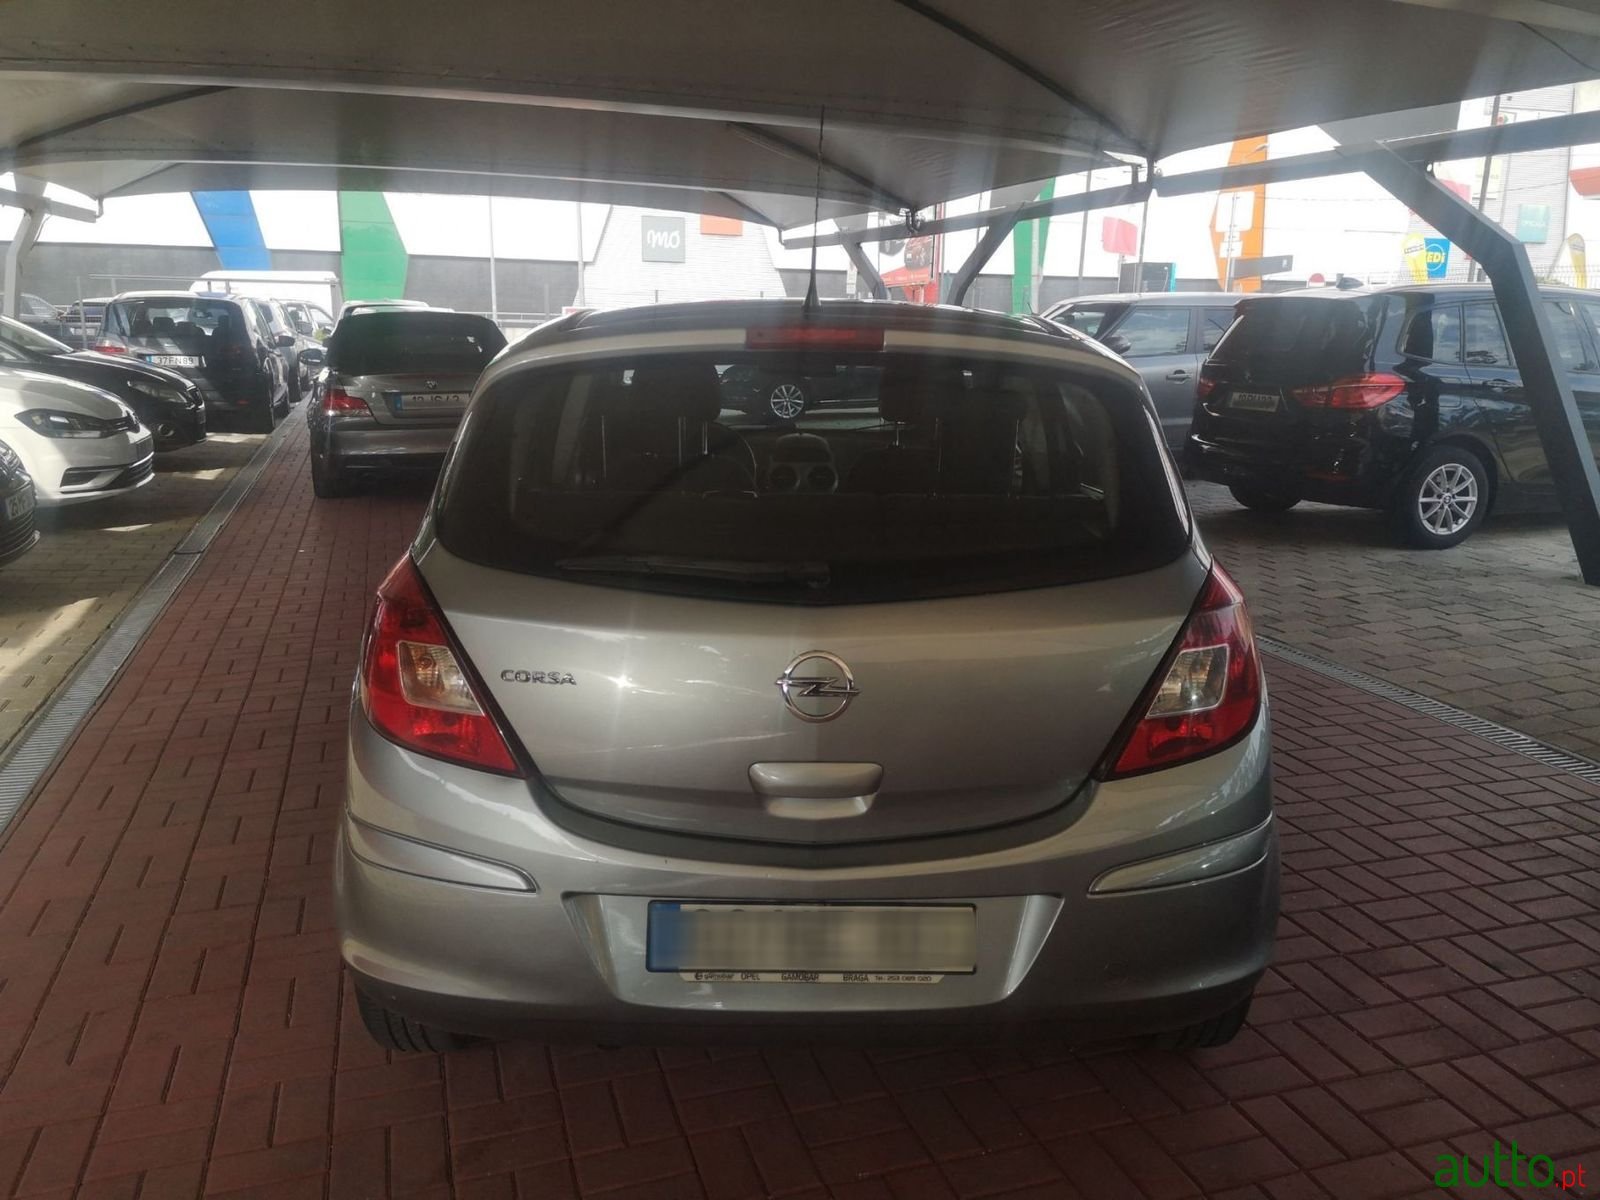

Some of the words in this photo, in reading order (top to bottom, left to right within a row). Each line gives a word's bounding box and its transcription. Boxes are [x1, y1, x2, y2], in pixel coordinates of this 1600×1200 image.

[500, 669, 577, 686] CORSA
[740, 972, 761, 981] OPEL
[781, 972, 820, 982] GAMOBAR
[842, 973, 869, 982] BRAGA
